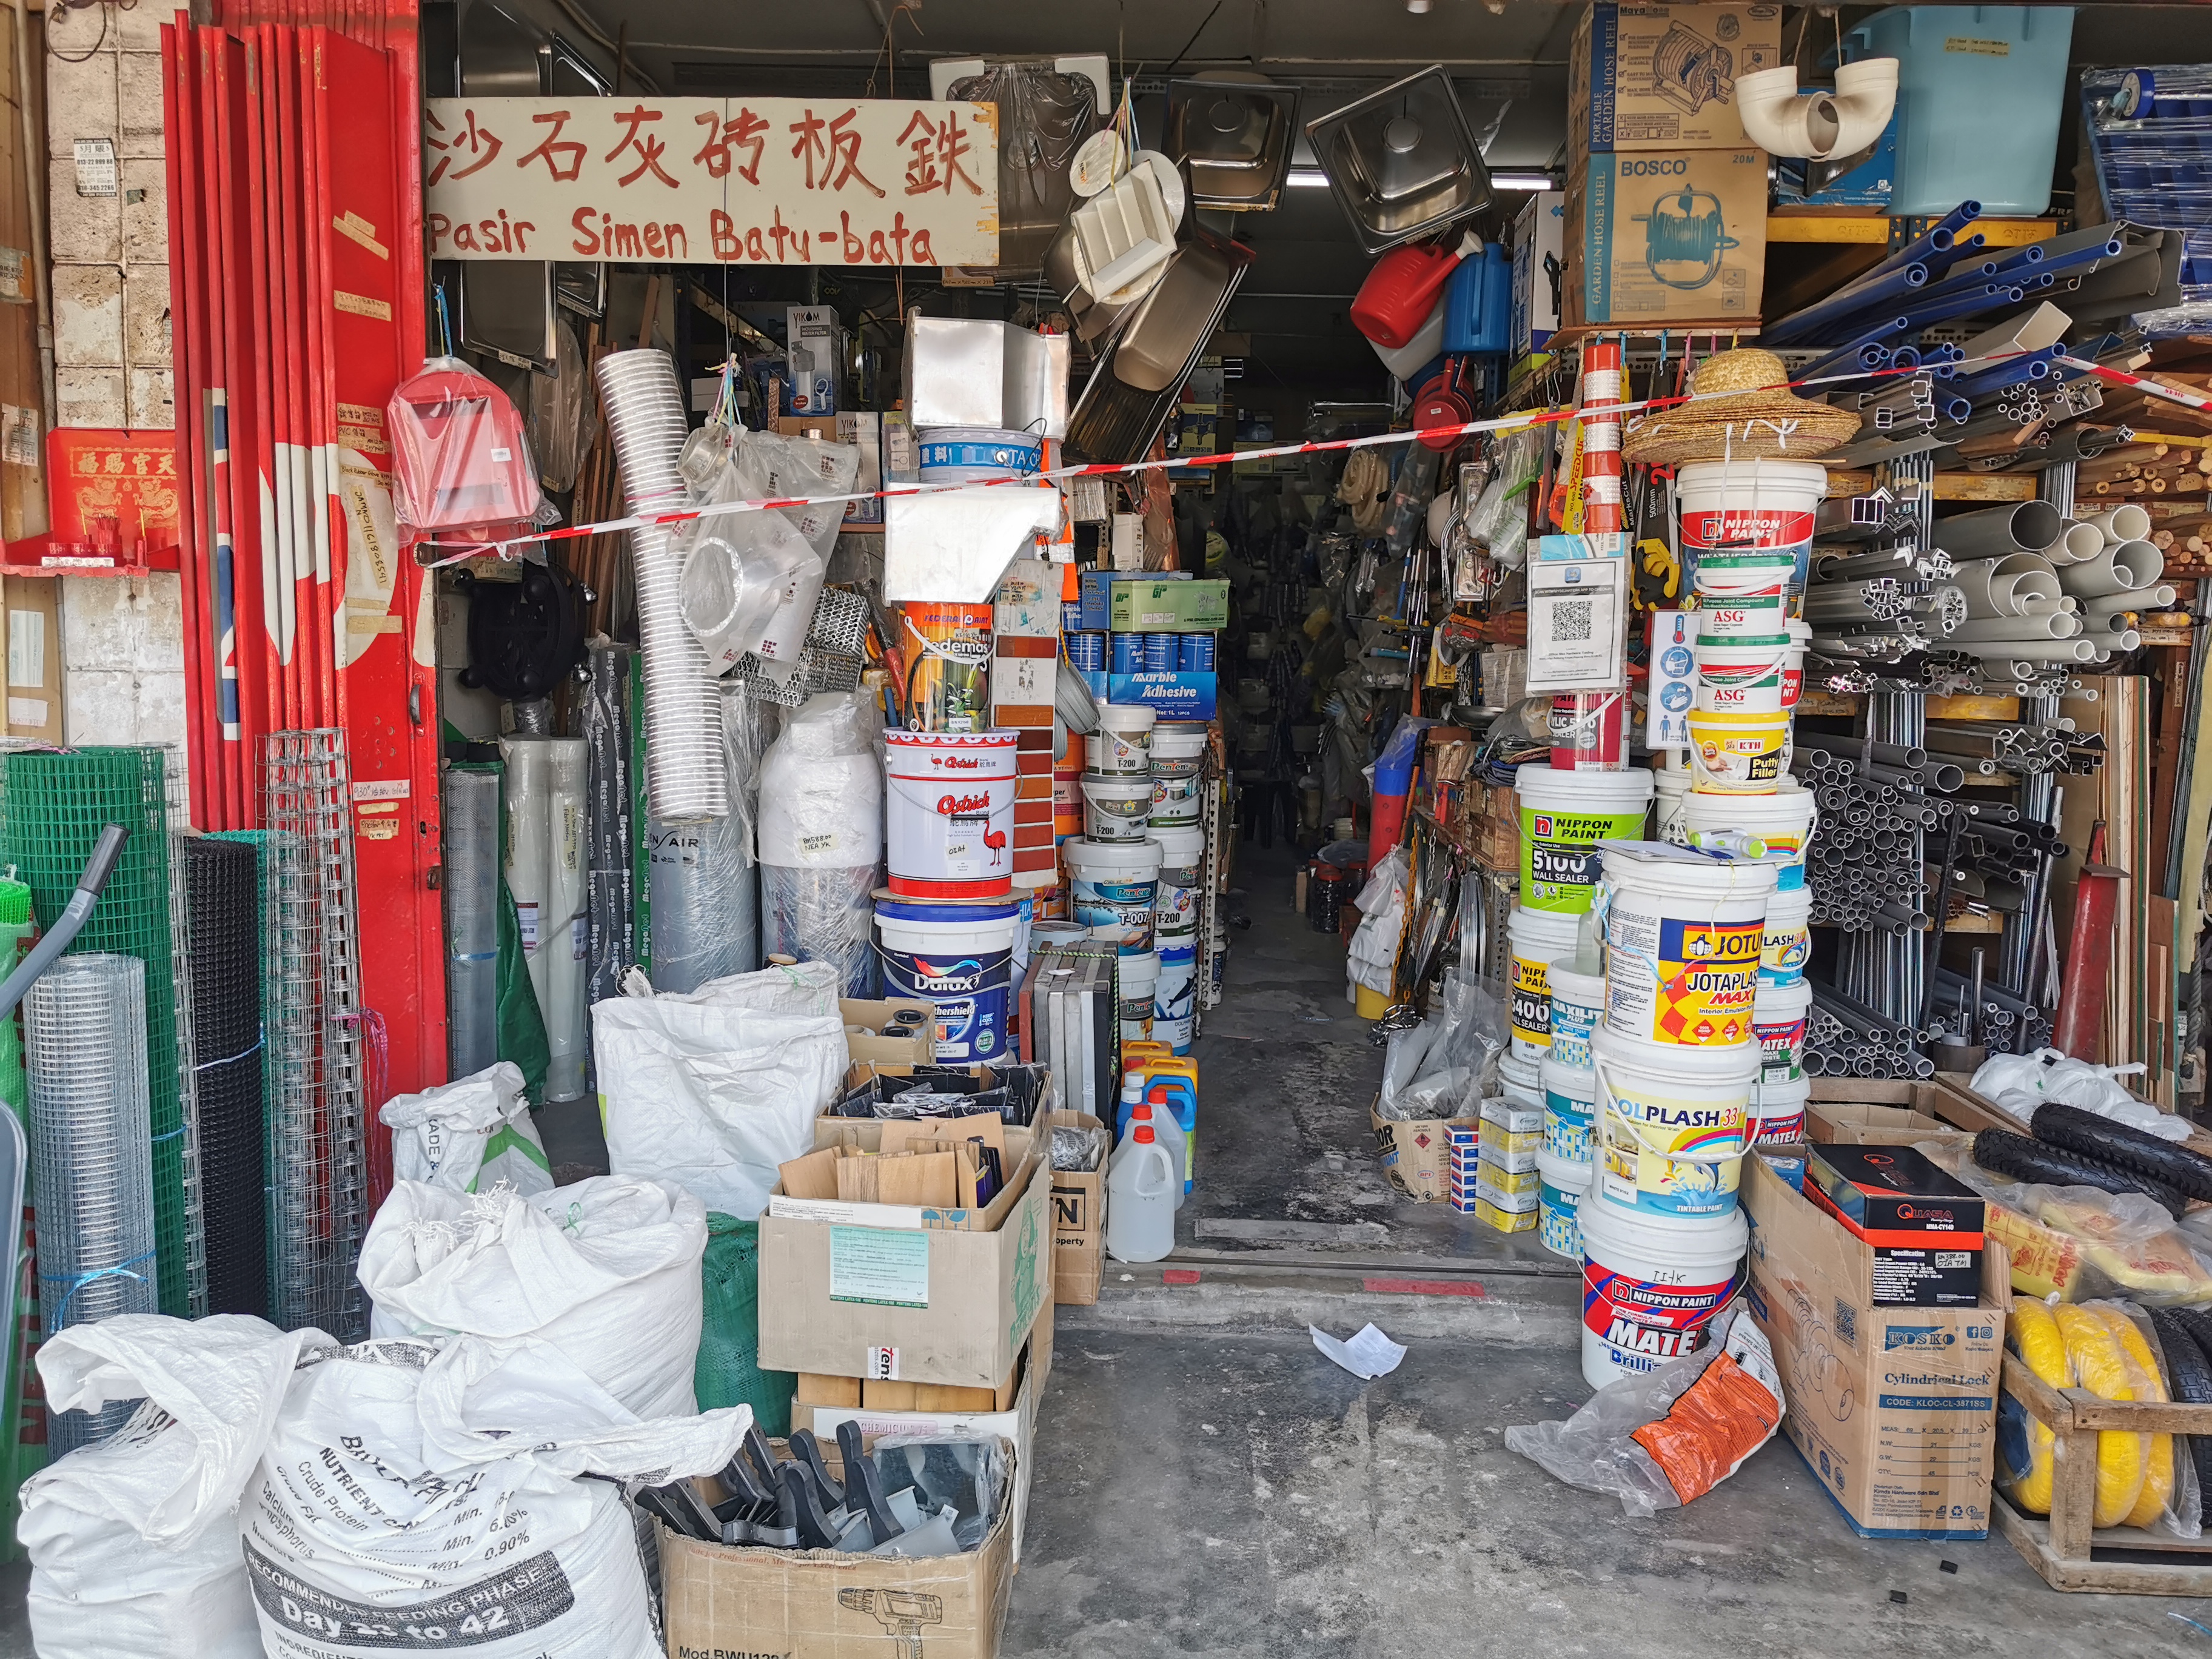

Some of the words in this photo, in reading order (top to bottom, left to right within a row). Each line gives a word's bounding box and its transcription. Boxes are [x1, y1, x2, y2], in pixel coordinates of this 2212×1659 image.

[1606, 17, 1616, 48] REEL
[1604, 51, 1615, 85] HOSE
[1592, 92, 1602, 143] PORTABLE
[1603, 89, 1614, 142] GARDEN
[1732, 155, 1754, 164] 20M
[1621, 160, 1687, 176] BOSCO
[1595, 170, 1606, 204] REEL
[1594, 206, 1604, 248] HOSE
[429, 209, 535, 253] Pasir
[572, 206, 687, 258] Simen
[711, 205, 937, 266] Batu-bata
[1592, 249, 1603, 304] GARDEN
[1725, 520, 1781, 529] NIPPON
[1730, 529, 1773, 538] PAINT
[1115, 593, 1129, 602] GP
[1152, 585, 1167, 598] GP
[1714, 611, 1744, 622] ASG
[1131, 672, 1177, 683] Marble
[1142, 685, 1197, 697] Adhesive
[1714, 689, 1744, 701] ASG
[945, 756, 978, 769] Ostrich
[1118, 759, 1136, 768] T-200
[1753, 758, 1779, 769] Putty
[1752, 768, 1777, 779] Filler
[937, 790, 990, 816] Ostrich
[1096, 826, 1114, 835] T-200
[1556, 819, 1613, 830] NIPPON
[1561, 830, 1606, 839] PAINT
[669, 838, 700, 848] AIR
[1533, 870, 1553, 881] WALL
[1555, 873, 1589, 883] SEALER
[1118, 911, 1150, 926] T-007
[1156, 913, 1180, 924] T-200
[914, 974, 975, 991] Dulux
[1687, 970, 1758, 991] JOTAPLAS
[1709, 990, 1752, 1005] MAX
[1552, 999, 1604, 1020] MAXILIT
[1521, 1019, 1547, 1033] SEALER
[1567, 1015, 1585, 1024] PLUS
[1722, 1107, 1738, 1127] 33
[1759, 1130, 1797, 1145] MATEX
[1708, 1204, 1723, 1212] PAINT
[1633, 1291, 1681, 1307] NIPPON
[1681, 1296, 1714, 1307] PAINT
[1607, 1318, 1698, 1356] MATE
[1888, 1332, 1956, 1346] KOSKO
[1885, 1373, 1956, 1386] Cylindrical
[1959, 1375, 1989, 1386] Lock
[320, 1447, 386, 1516] NUTRIENT
[263, 1481, 295, 1525] Calcium
[298, 1461, 326, 1498] Crude
[324, 1495, 369, 1530] Protein
[454, 1507, 483, 1526] Min.
[443, 1535, 475, 1552] Min.
[484, 1529, 530, 1561] 0.90%
[247, 1551, 366, 1620] RECOMMENDED
[281, 1595, 343, 1637] Day
[404, 1623, 447, 1641] to
[460, 1606, 509, 1636] 42
